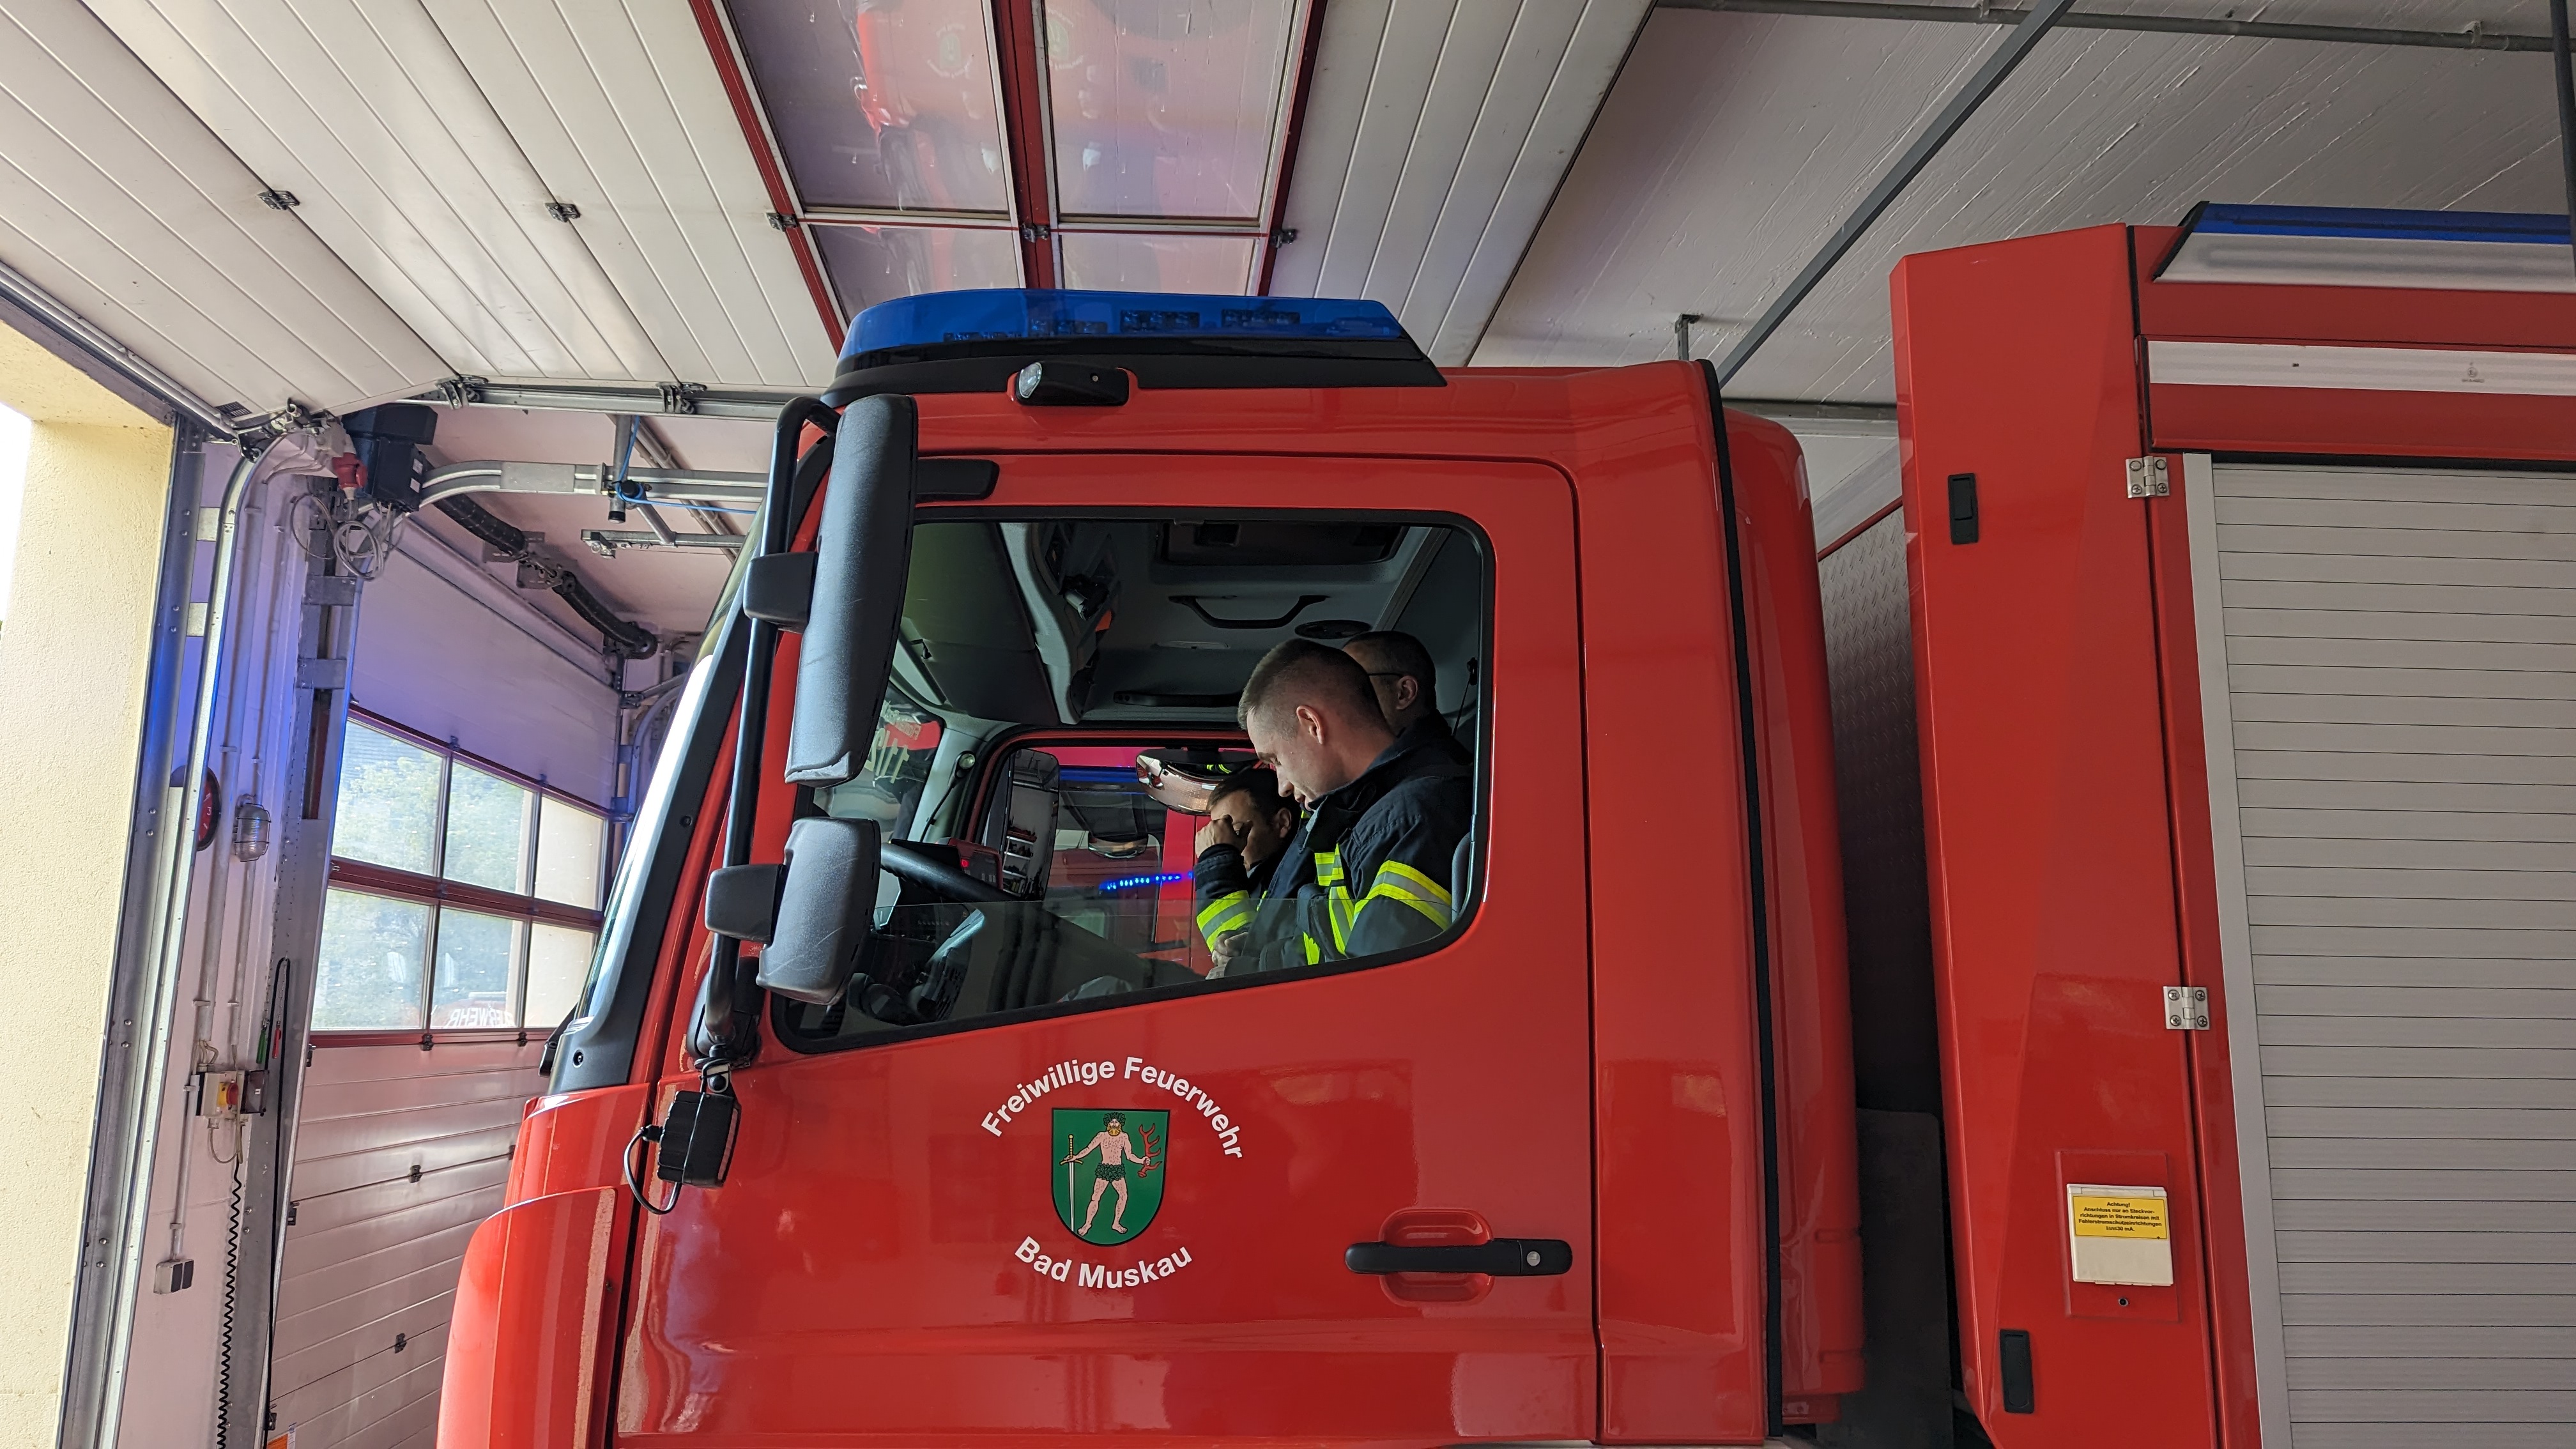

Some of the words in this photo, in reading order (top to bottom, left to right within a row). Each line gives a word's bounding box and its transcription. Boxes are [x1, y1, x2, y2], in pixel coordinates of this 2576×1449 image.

[981, 1059, 1116, 1137] Freiwillige
[1123, 1056, 1242, 1159] Feuerwehr
[2078, 1218, 2162, 1227] Fehlerstromschutzeinrichtungen
[1015, 1236, 1073, 1282] Bad
[1078, 1246, 1193, 1289] Muskau
